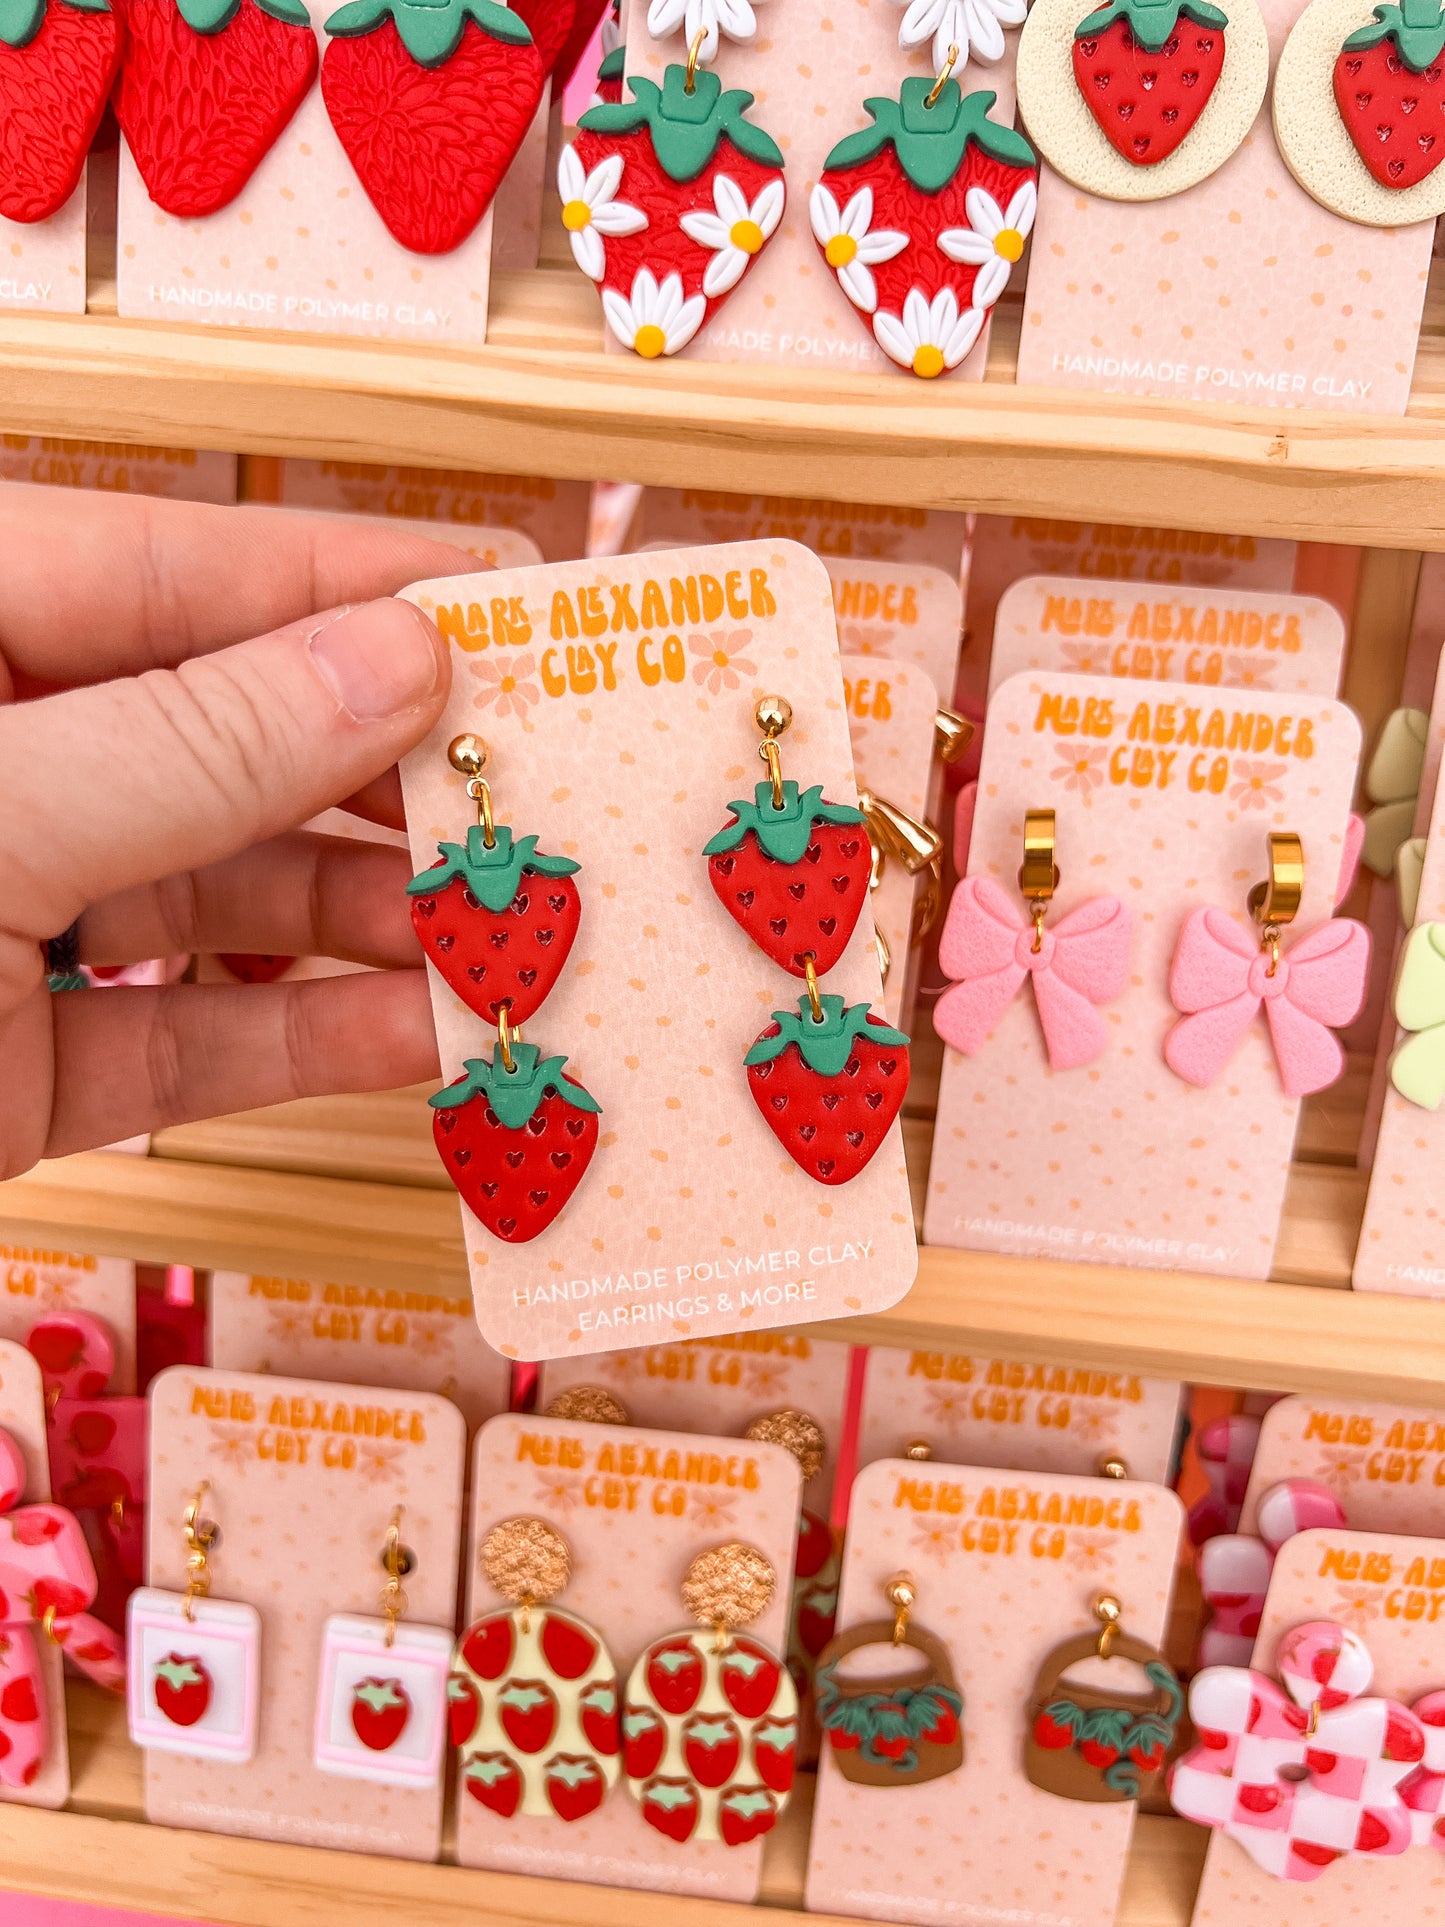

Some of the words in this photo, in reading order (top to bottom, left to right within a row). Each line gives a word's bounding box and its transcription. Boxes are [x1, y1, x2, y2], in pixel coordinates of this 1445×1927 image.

[0, 280, 51, 301] CLAY
[151, 285, 278, 313] HANDMADE
[284, 296, 390, 321] POLYMER
[395, 305, 451, 327] CLAY
[700, 329, 772, 351] MADE
[778, 333, 880, 361] POLYME
[1051, 354, 1188, 383] HANDMADE
[1194, 367, 1307, 392] POLYMER
[1312, 376, 1373, 399] CLAY
[436, 595, 533, 653] MARK
[549, 567, 777, 641] ALEXANDER
[1041, 595, 1116, 637] MARK
[1126, 602, 1301, 654] ALEXANDER
[540, 640, 620, 698] CLAY
[636, 634, 686, 688] CO
[1110, 643, 1172, 680] CLAY
[1184, 649, 1223, 686] CO
[1033, 692, 1115, 738] MARK
[1127, 702, 1316, 760] ALEXANDER
[1108, 745, 1177, 790] CLAY
[1188, 753, 1229, 795] CO
[955, 1215, 1077, 1244] HANDMADE
[512, 1268, 669, 1307] HANDMADE
[676, 1251, 802, 1283] POLYMER
[808, 1240, 874, 1265] CLAY
[577, 1294, 711, 1332] EARRINGS
[716, 1292, 734, 1312] &
[740, 1280, 818, 1309] MORE
[268, 1394, 426, 1444] ALEXANDER
[1303, 1411, 1374, 1447] MARK
[322, 1435, 356, 1470] CO
[596, 1441, 762, 1493] ALEXANDER
[1366, 1451, 1425, 1485] CLAY
[652, 1482, 688, 1517] CO
[893, 1478, 966, 1515] MARK
[975, 1486, 1142, 1533] ALEXANDER
[961, 1520, 1019, 1556] CLAY
[1028, 1526, 1067, 1559] CO
[1318, 1547, 1393, 1584] MARK
